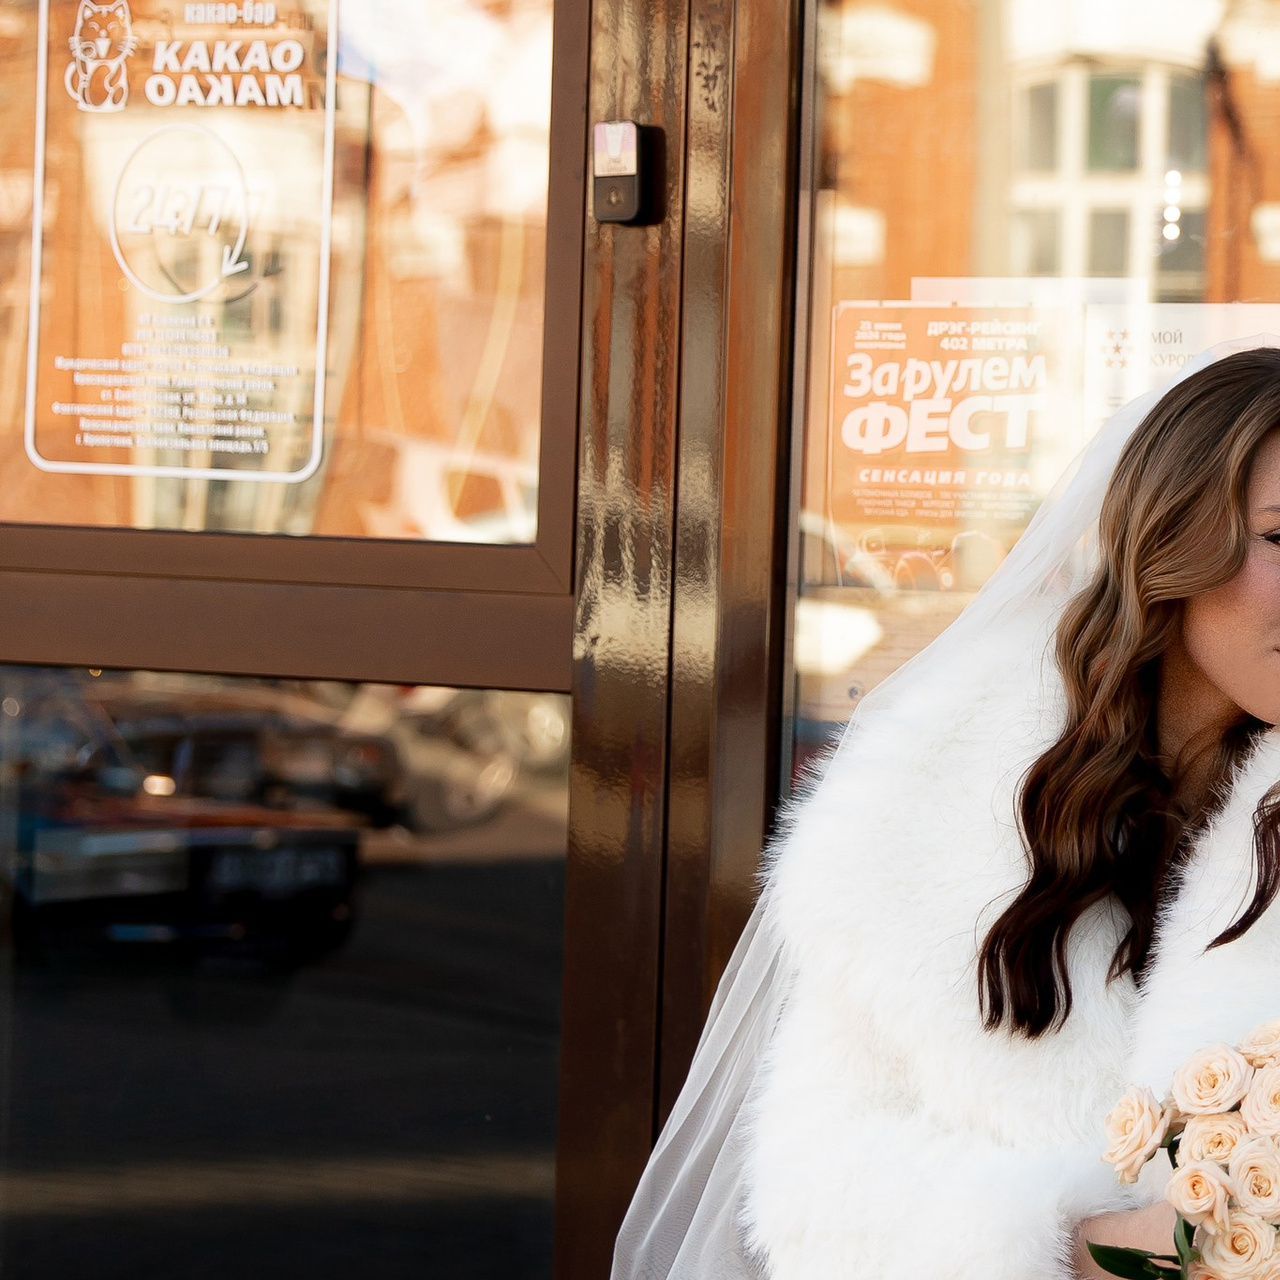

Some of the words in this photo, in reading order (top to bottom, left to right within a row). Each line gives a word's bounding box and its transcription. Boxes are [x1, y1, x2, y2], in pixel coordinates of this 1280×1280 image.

[184, 0, 275, 25] какао-бар
[152, 39, 304, 73] КАКАО
[940, 337, 968, 350] 402
[972, 337, 1029, 350] МЕТРА
[1151, 329, 1183, 344] МОЙ
[841, 393, 1048, 455] ФЕСТ
[859, 468, 966, 485] СЕНСАЦИЯ
[975, 471, 1030, 487] ГОДА
